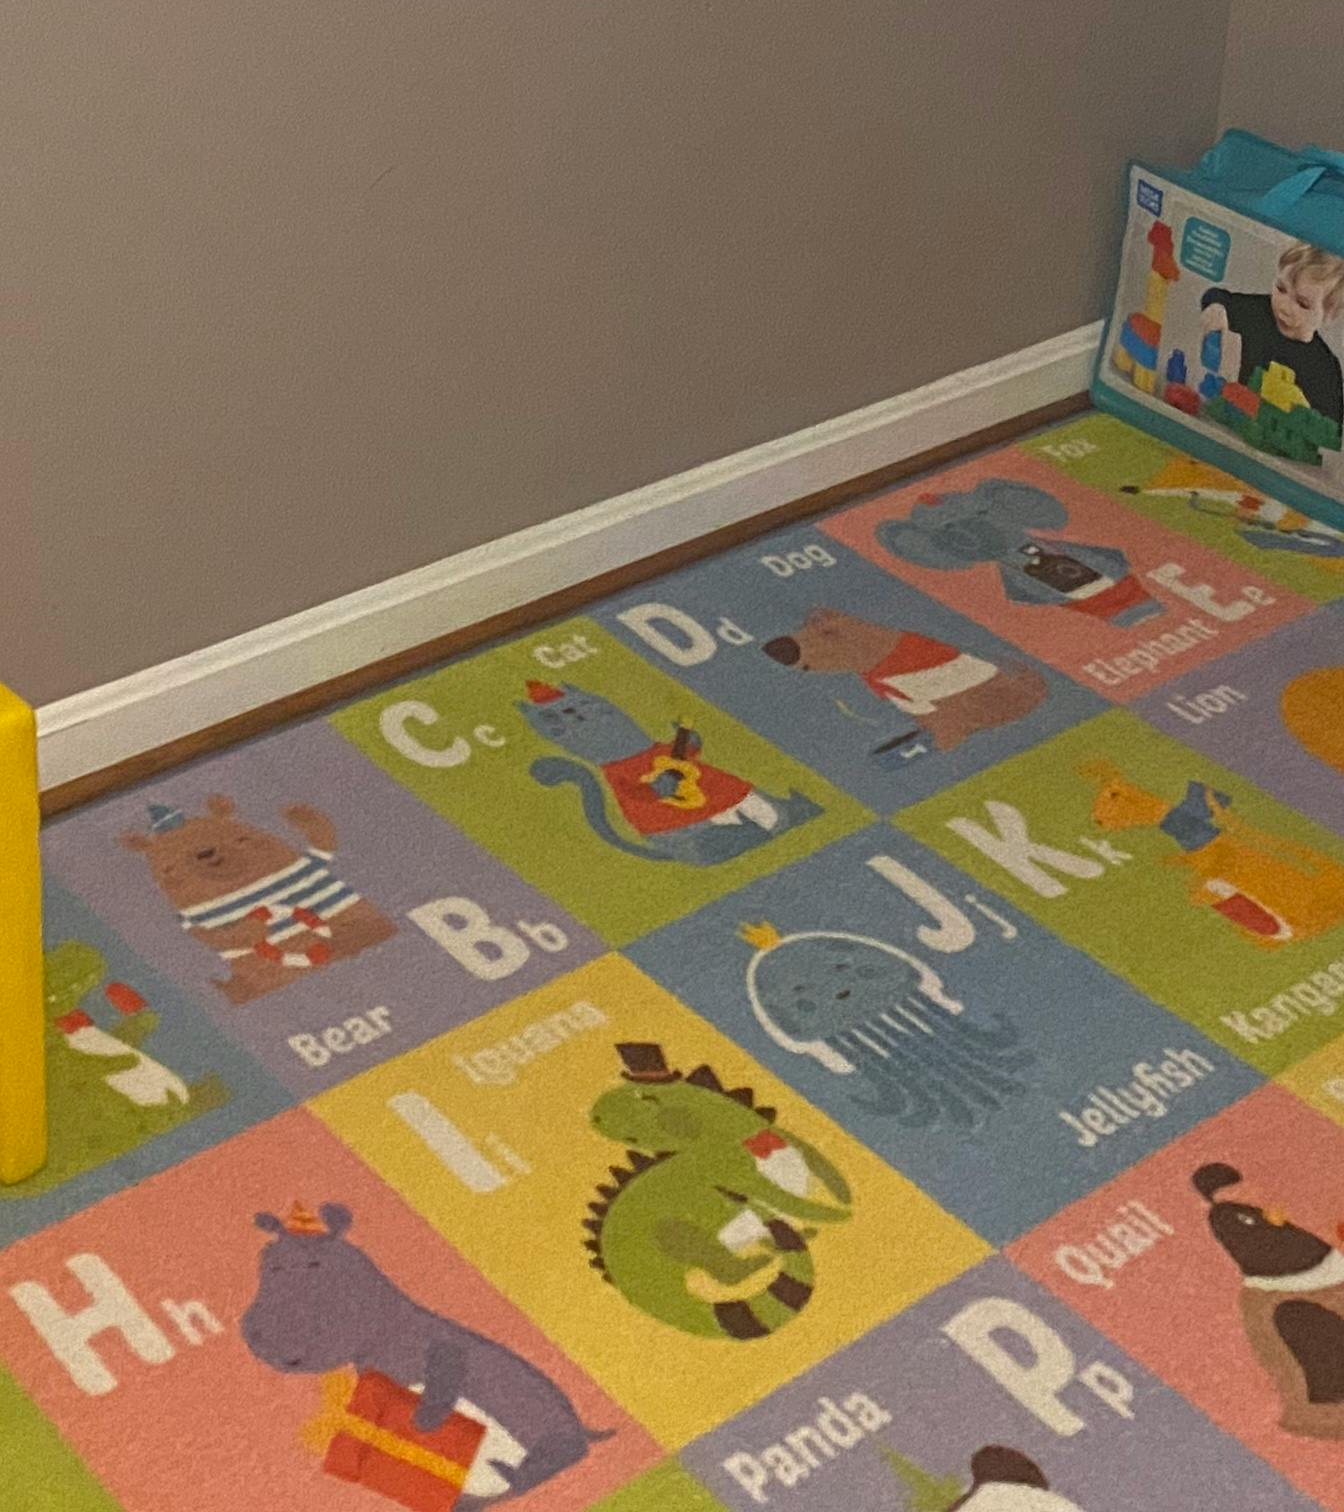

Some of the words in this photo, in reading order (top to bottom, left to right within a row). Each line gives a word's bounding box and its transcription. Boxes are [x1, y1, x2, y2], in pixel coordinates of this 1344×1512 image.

[760, 541, 837, 581] Dog
[530, 632, 601, 674] Cat
[1082, 618, 1219, 686] Elephant
[1166, 684, 1248, 725] Lion
[287, 1005, 395, 1067] Bear
[454, 1000, 609, 1087] Iguana
[1058, 1043, 1215, 1148] Jellyfish
[1056, 1200, 1175, 1289] Quail
[722, 1387, 894, 1503] Panda
